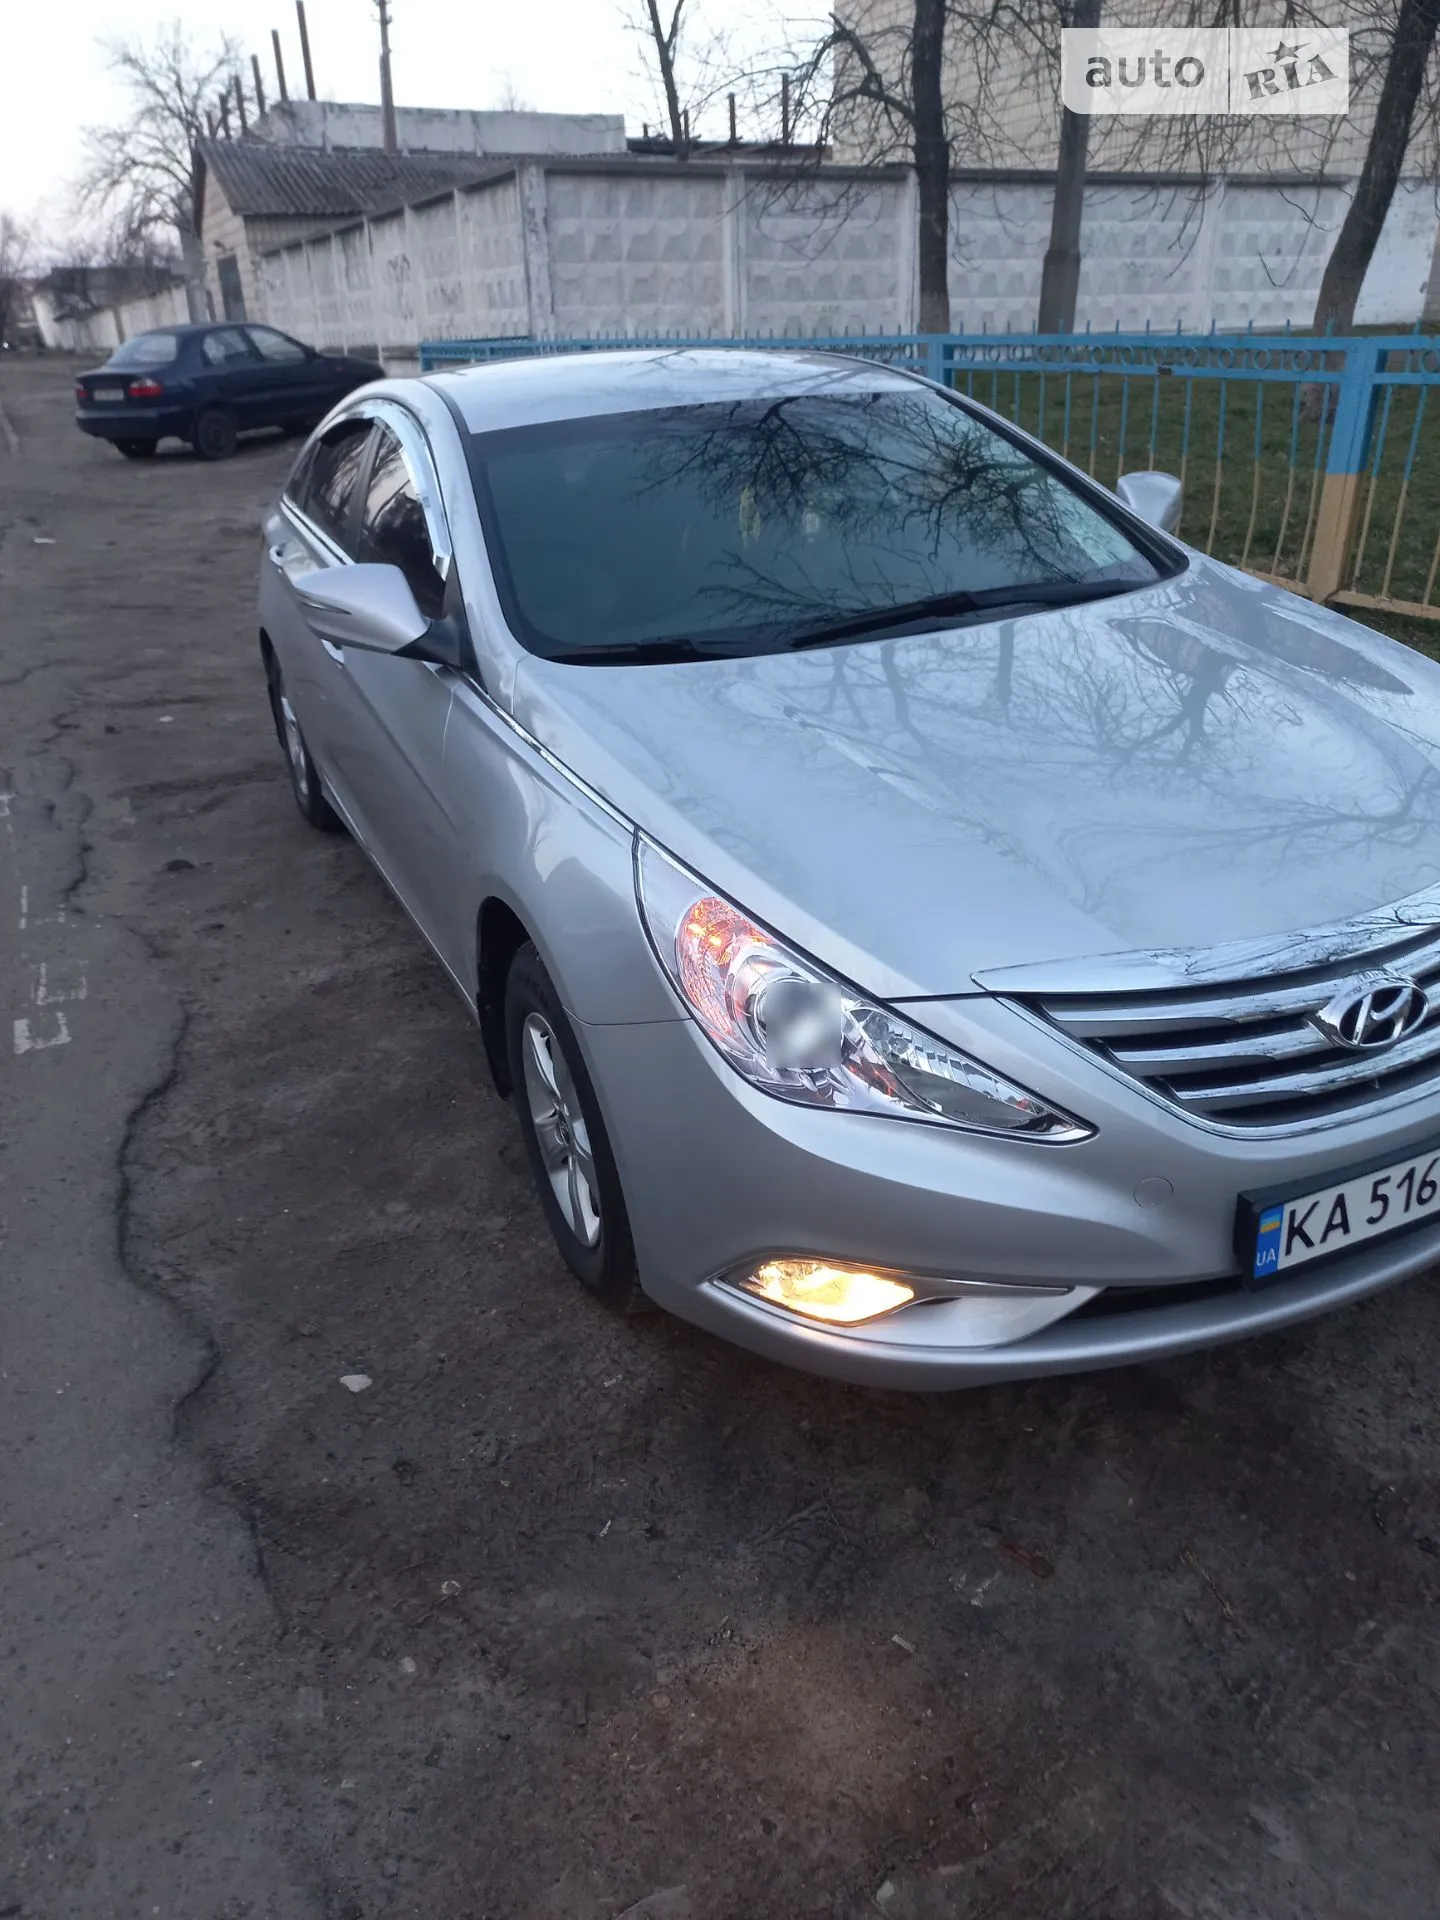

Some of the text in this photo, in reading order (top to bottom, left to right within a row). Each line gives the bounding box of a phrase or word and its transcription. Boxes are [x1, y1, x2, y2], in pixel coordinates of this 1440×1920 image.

[1284, 1156, 1440, 1256] KA 516
[1256, 1248, 1276, 1266] UA
